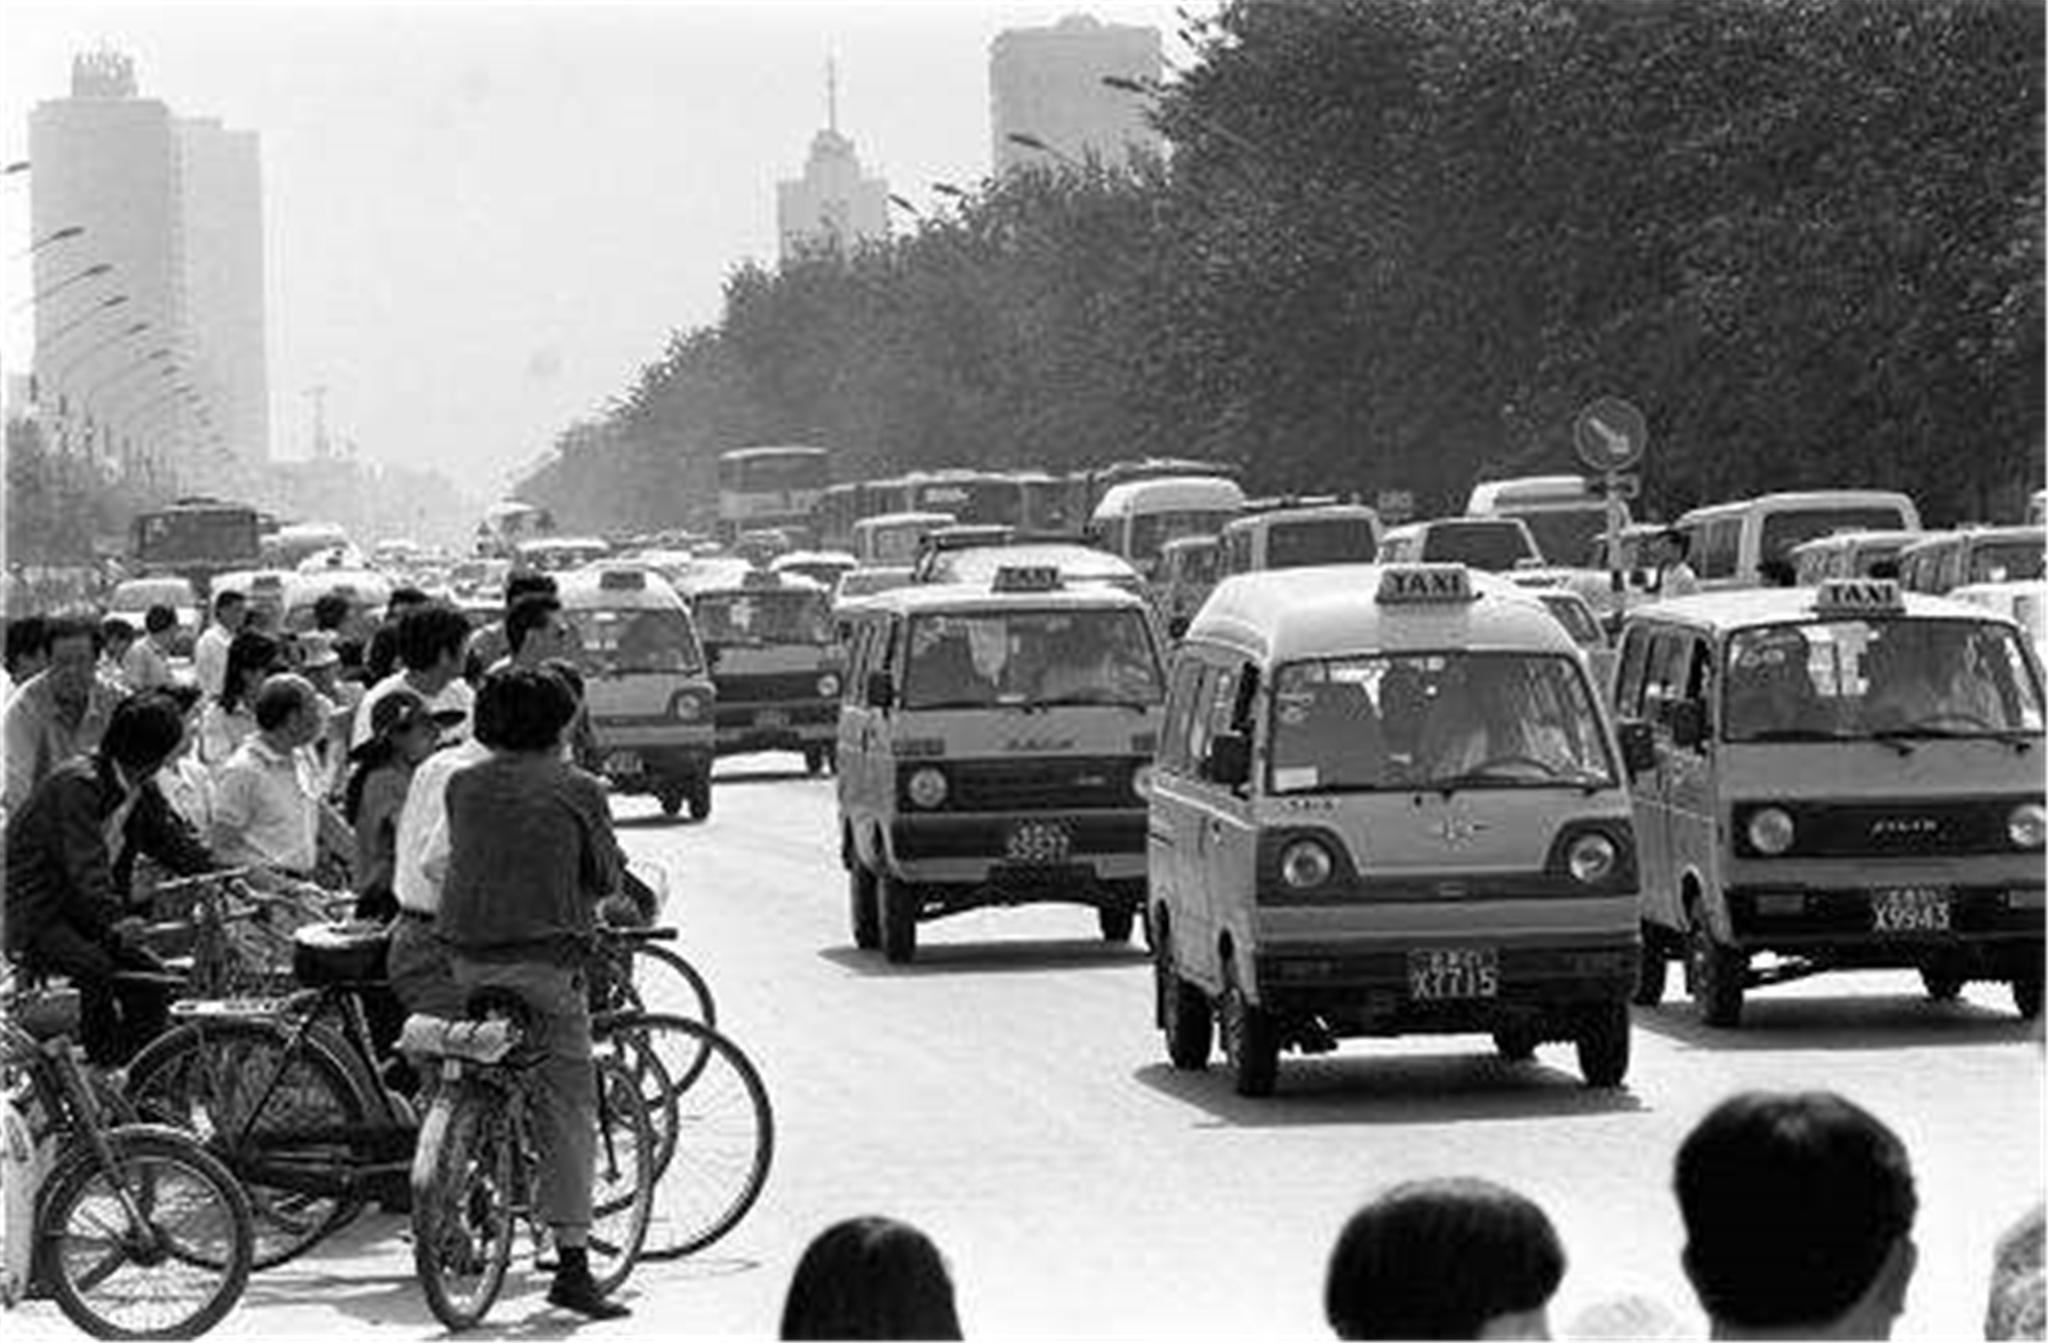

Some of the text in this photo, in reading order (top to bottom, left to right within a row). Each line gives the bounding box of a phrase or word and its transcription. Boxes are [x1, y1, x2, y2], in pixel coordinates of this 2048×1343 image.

[1391, 571, 1459, 593] TAXI
[1827, 584, 1893, 603] TAXI
[1411, 968, 1498, 999] X7715
